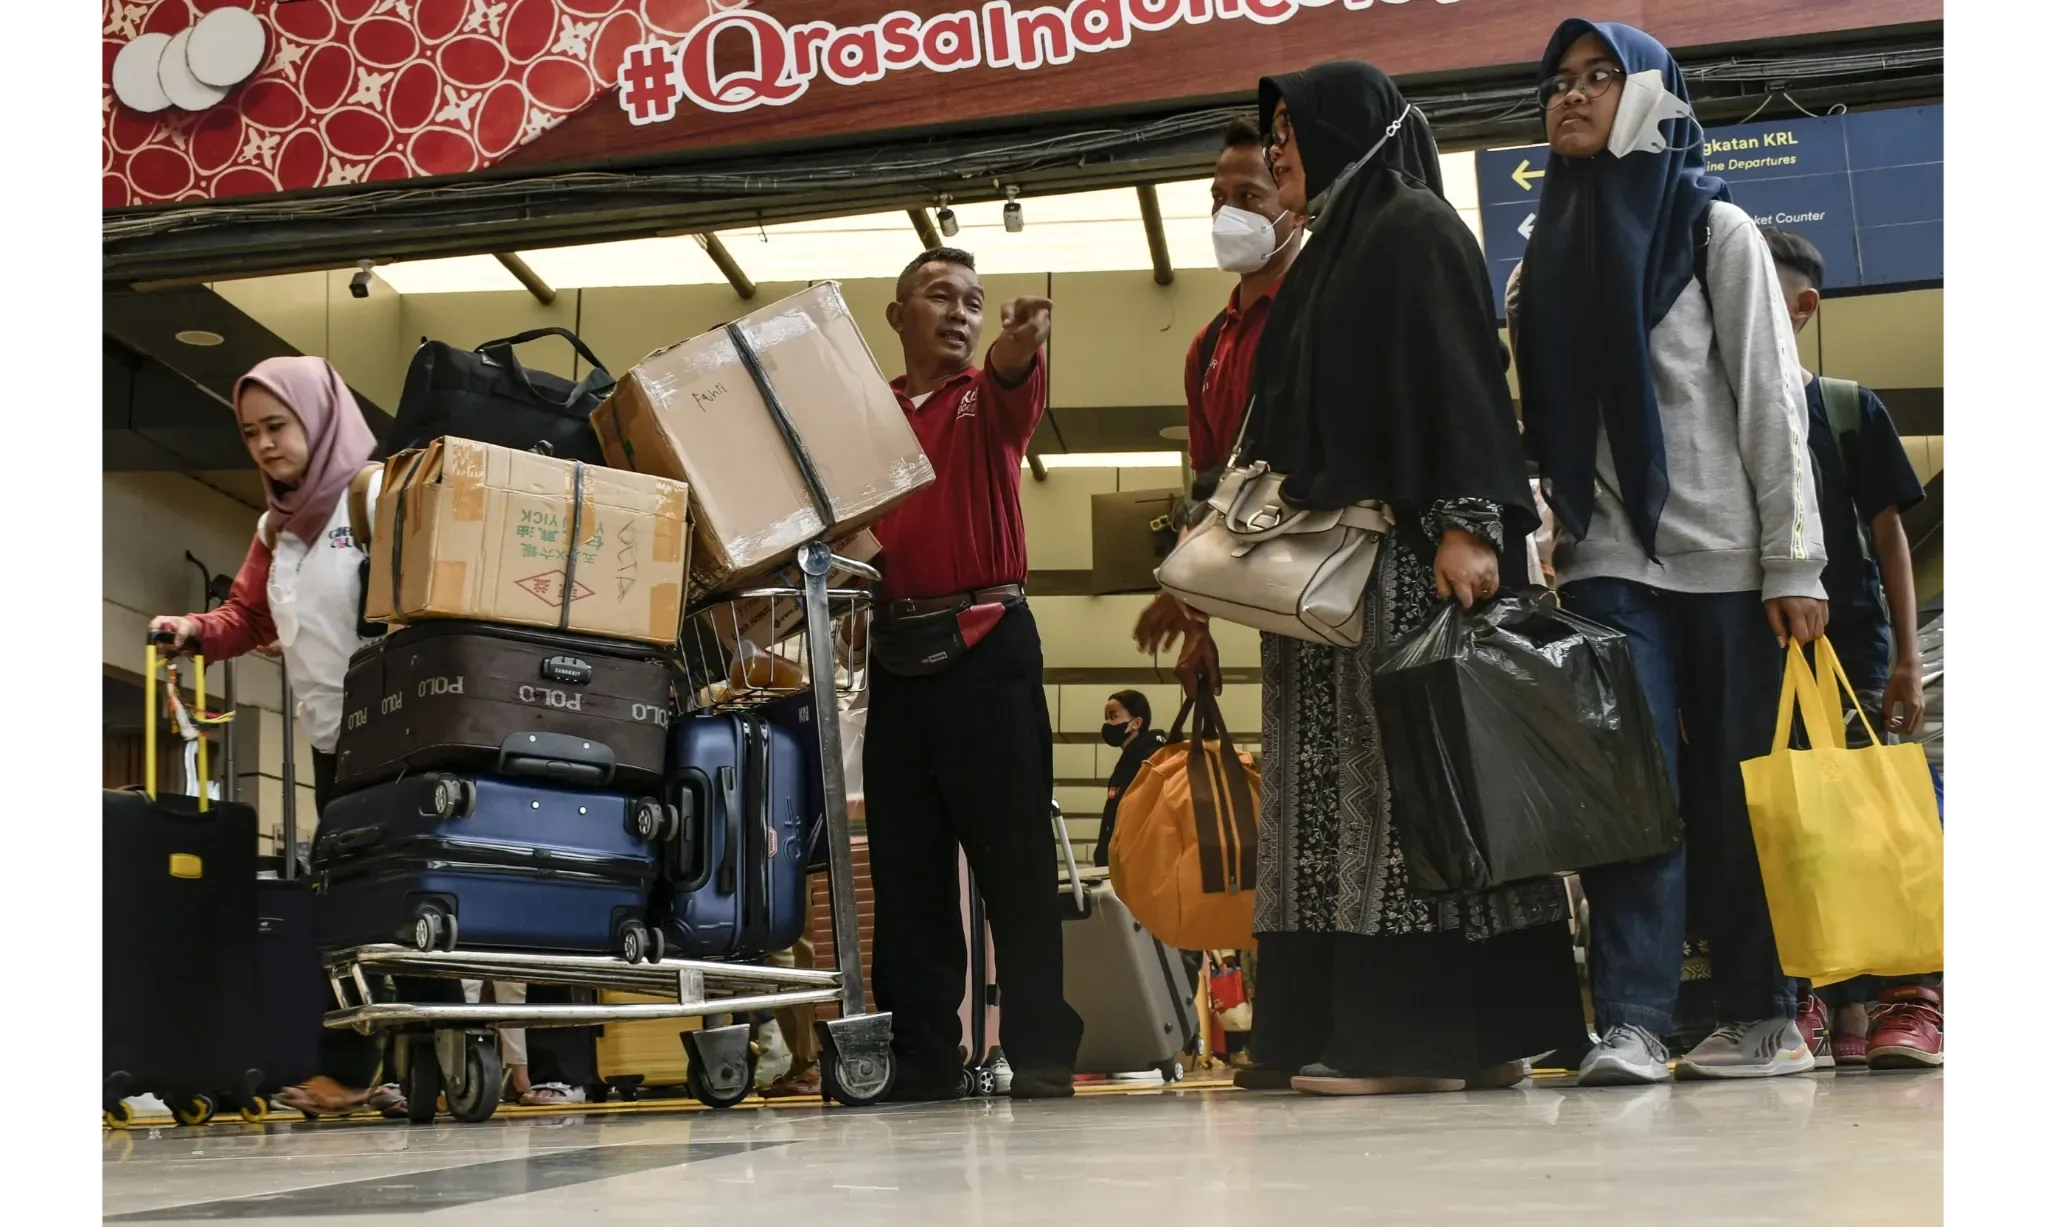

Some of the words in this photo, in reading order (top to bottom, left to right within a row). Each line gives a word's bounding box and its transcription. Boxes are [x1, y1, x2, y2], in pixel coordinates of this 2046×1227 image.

[617, 0, 1460, 126] #QrasaInd
[1703, 137, 1759, 156] gkatan
[1763, 131, 1798, 147] KRL
[1706, 161, 1725, 172] ine
[1728, 155, 1797, 170] Departures
[1753, 214, 1772, 225] ket
[1775, 211, 1826, 224] Counter
[521, 509, 558, 527] YICK
[418, 676, 464, 697] POLO
[519, 685, 582, 711] POLO
[381, 691, 402, 715] POLO
[348, 707, 368, 730] POLO
[632, 703, 668, 728] OLO
